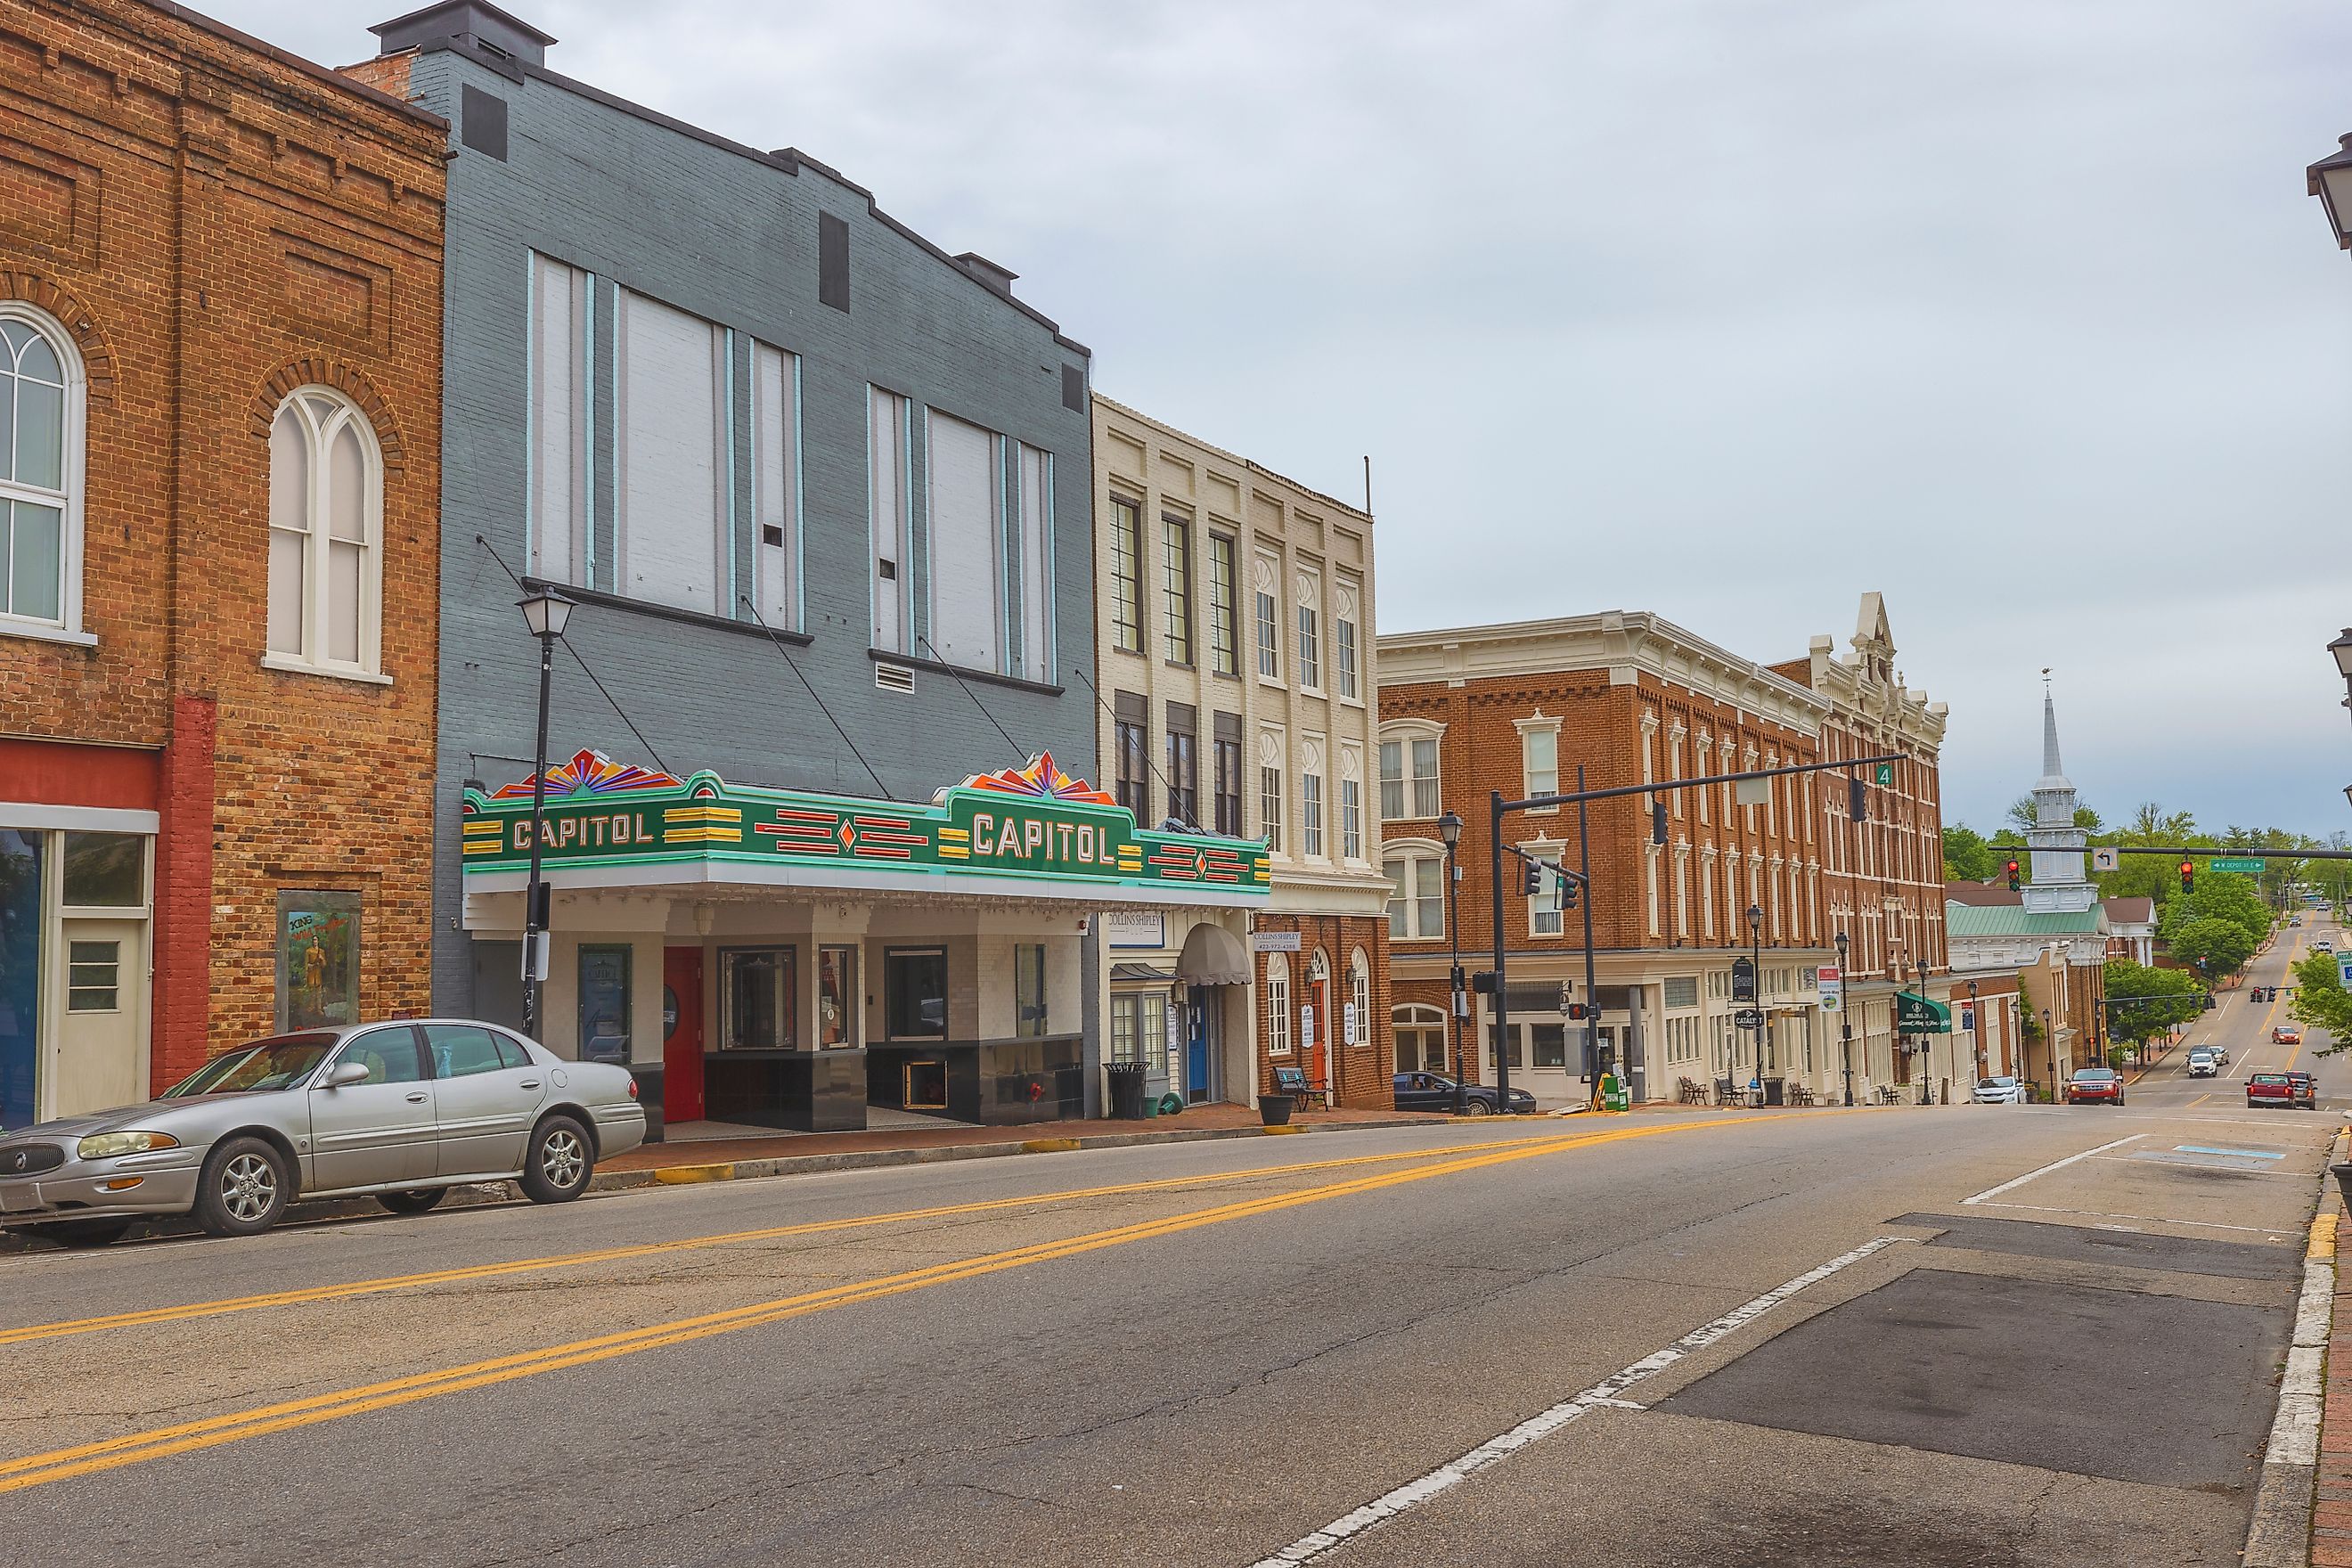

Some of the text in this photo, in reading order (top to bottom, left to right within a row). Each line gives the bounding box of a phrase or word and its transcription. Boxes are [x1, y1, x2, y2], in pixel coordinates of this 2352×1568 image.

[1880, 769, 1889, 783] 4
[514, 813, 654, 850] CAPITOL
[973, 813, 1116, 865] CAPITOL
[290, 915, 313, 931] KING
